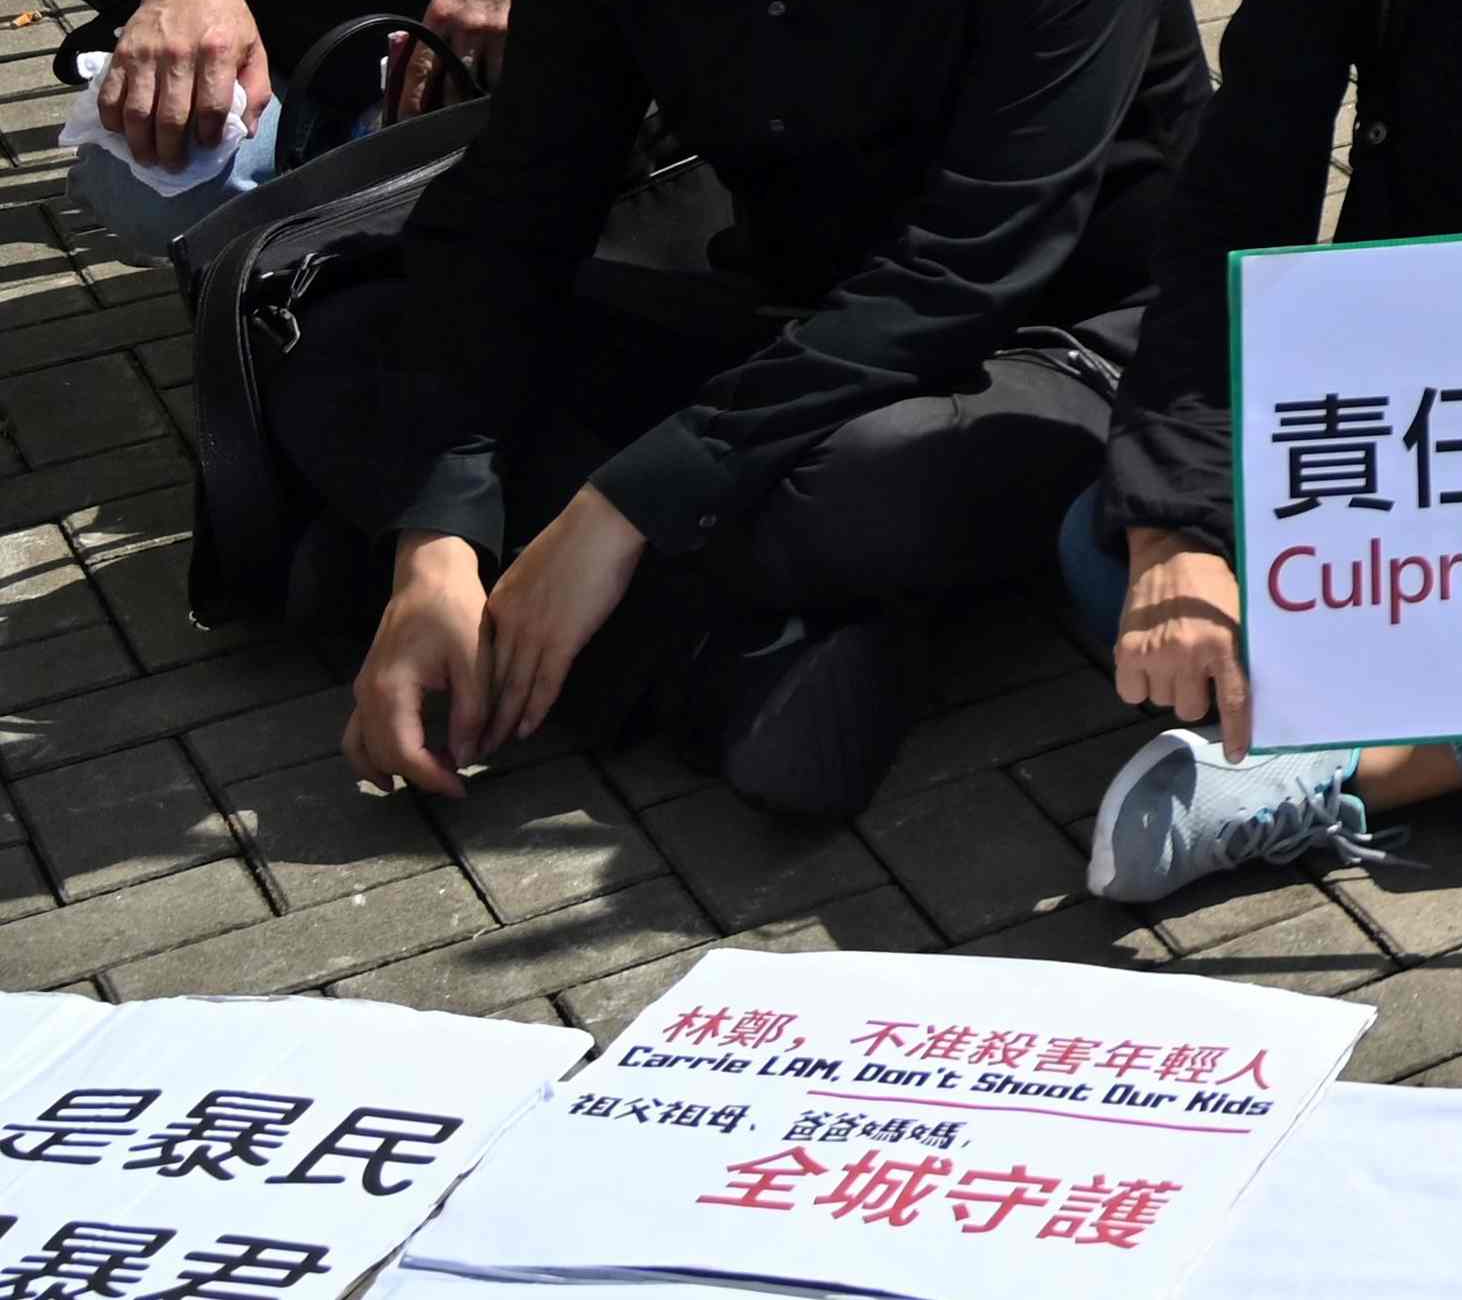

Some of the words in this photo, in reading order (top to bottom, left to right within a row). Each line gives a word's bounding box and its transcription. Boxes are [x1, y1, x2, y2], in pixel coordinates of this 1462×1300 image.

[618, 1047, 749, 1073] Carrie
[758, 1058, 840, 1079] LAM,
[854, 1064, 956, 1087] Don't
[972, 1074, 1085, 1100] Shoot
[1103, 1085, 1175, 1107] Our
[1185, 1092, 1267, 1115] Kids
[0, 1091, 459, 1195] 是暴民
[697, 1145, 1184, 1250] 全城守護
